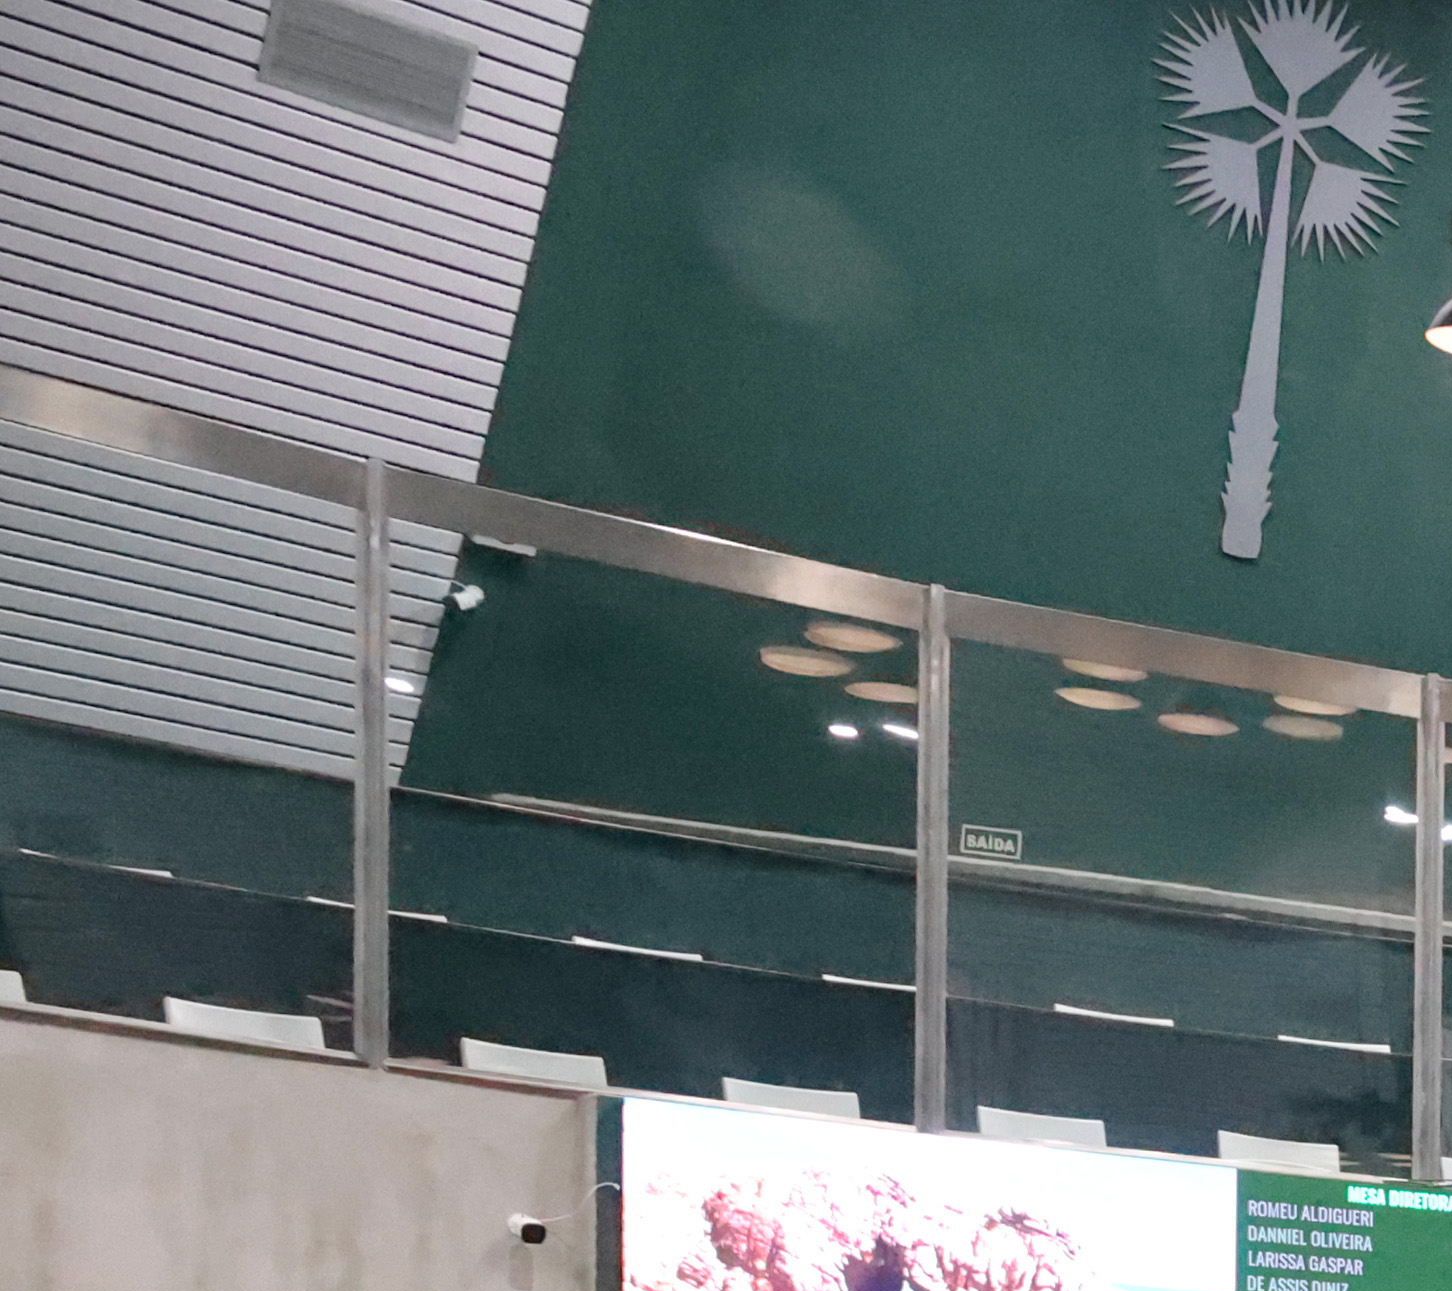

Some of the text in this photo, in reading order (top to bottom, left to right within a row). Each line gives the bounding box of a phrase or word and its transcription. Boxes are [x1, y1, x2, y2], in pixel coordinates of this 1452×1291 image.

[966, 833, 1016, 853] SAÍDA
[1348, 1186, 1386, 1205] MESA
[1248, 1200, 1373, 1227] ROMEU ALDIGUERI
[1248, 1225, 1373, 1252] DANNIEL OLIVEIRA
[1248, 1250, 1363, 1275] LARISSA GASPAR
[1247, 1275, 1265, 1291] DE
